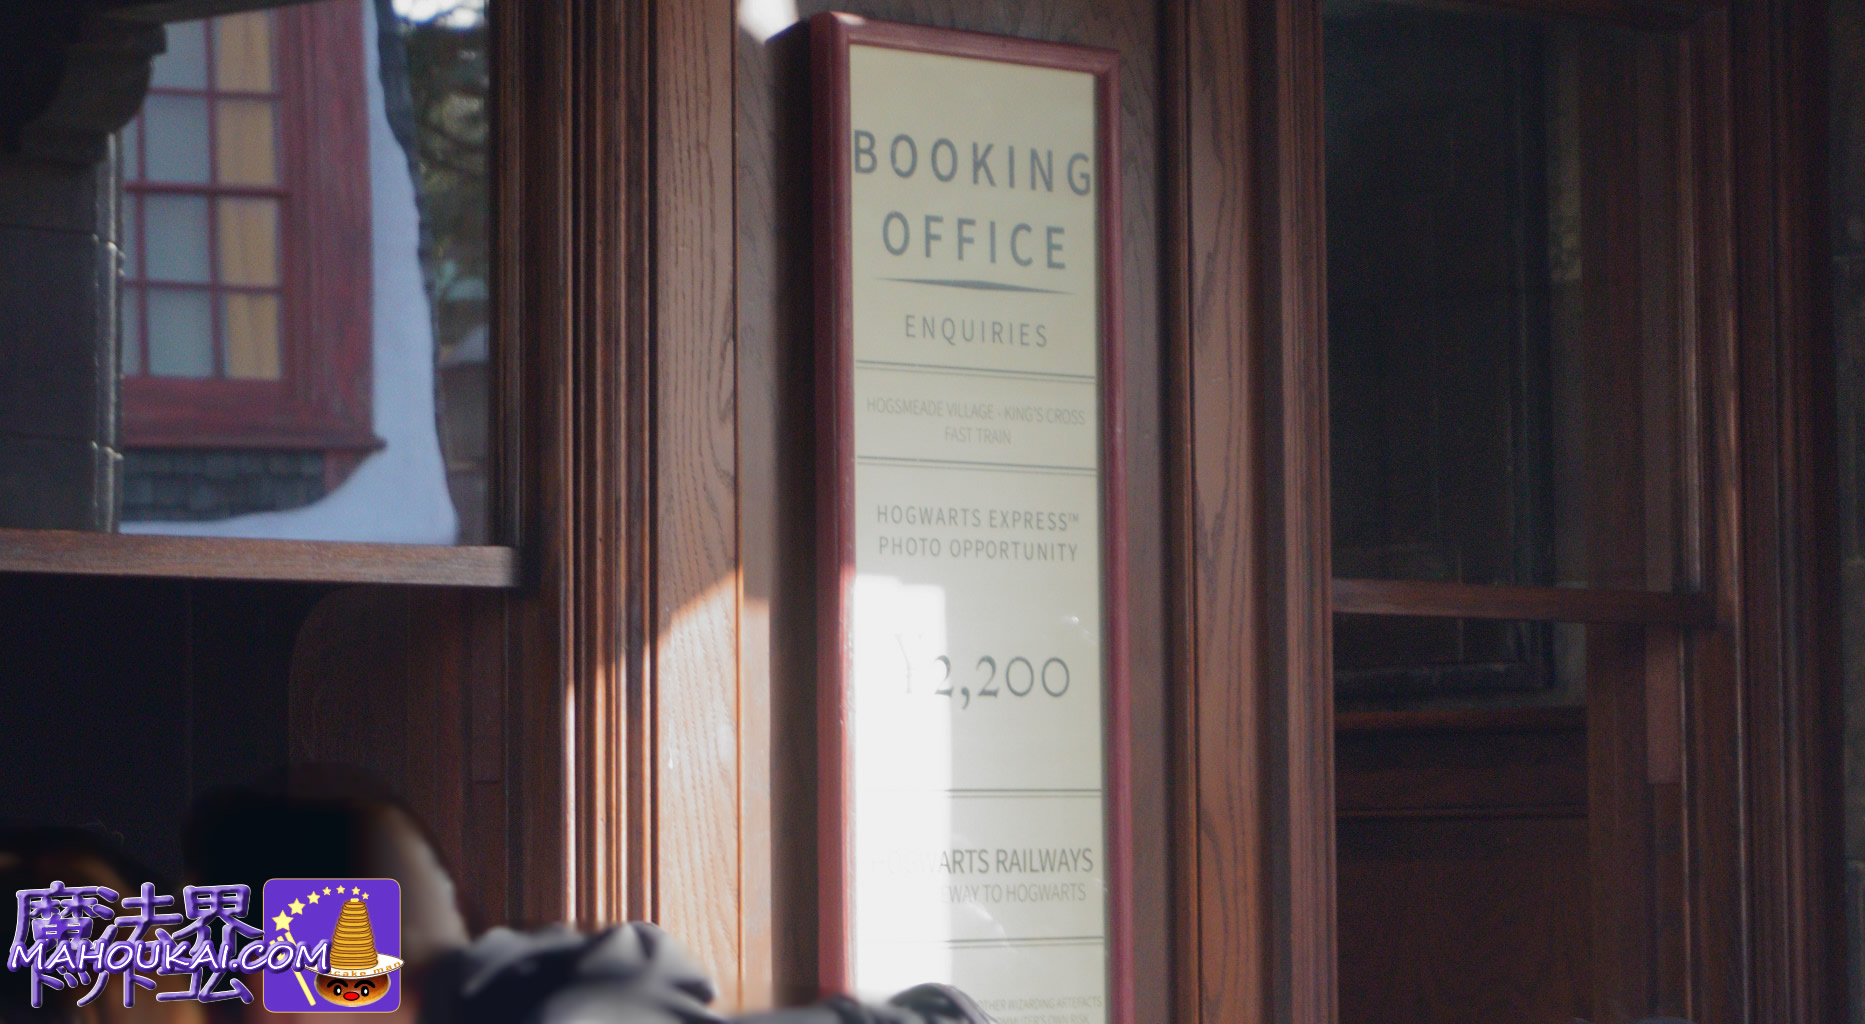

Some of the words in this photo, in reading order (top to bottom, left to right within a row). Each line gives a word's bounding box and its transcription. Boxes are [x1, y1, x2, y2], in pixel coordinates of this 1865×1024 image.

[853, 129, 1093, 198] BOOKING
[881, 210, 1067, 271] OFFICE
[904, 313, 1049, 349] ENQUIRIES
[866, 396, 944, 417] HOGSMEADE
[945, 401, 994, 420] VILLAGE
[1003, 404, 1044, 424] KING'S
[1046, 407, 1086, 426] CROSS
[944, 426, 972, 443] FAST
[975, 428, 1012, 445] TRAIN
[876, 504, 982, 528] HOGWARTS
[878, 535, 942, 558] PHOTO
[949, 538, 1079, 562] OPPORTUNITY
[995, 847, 1095, 874] RAILWAYS
[983, 883, 1002, 903] TO
[1006, 882, 1088, 903] HOGWARTS
